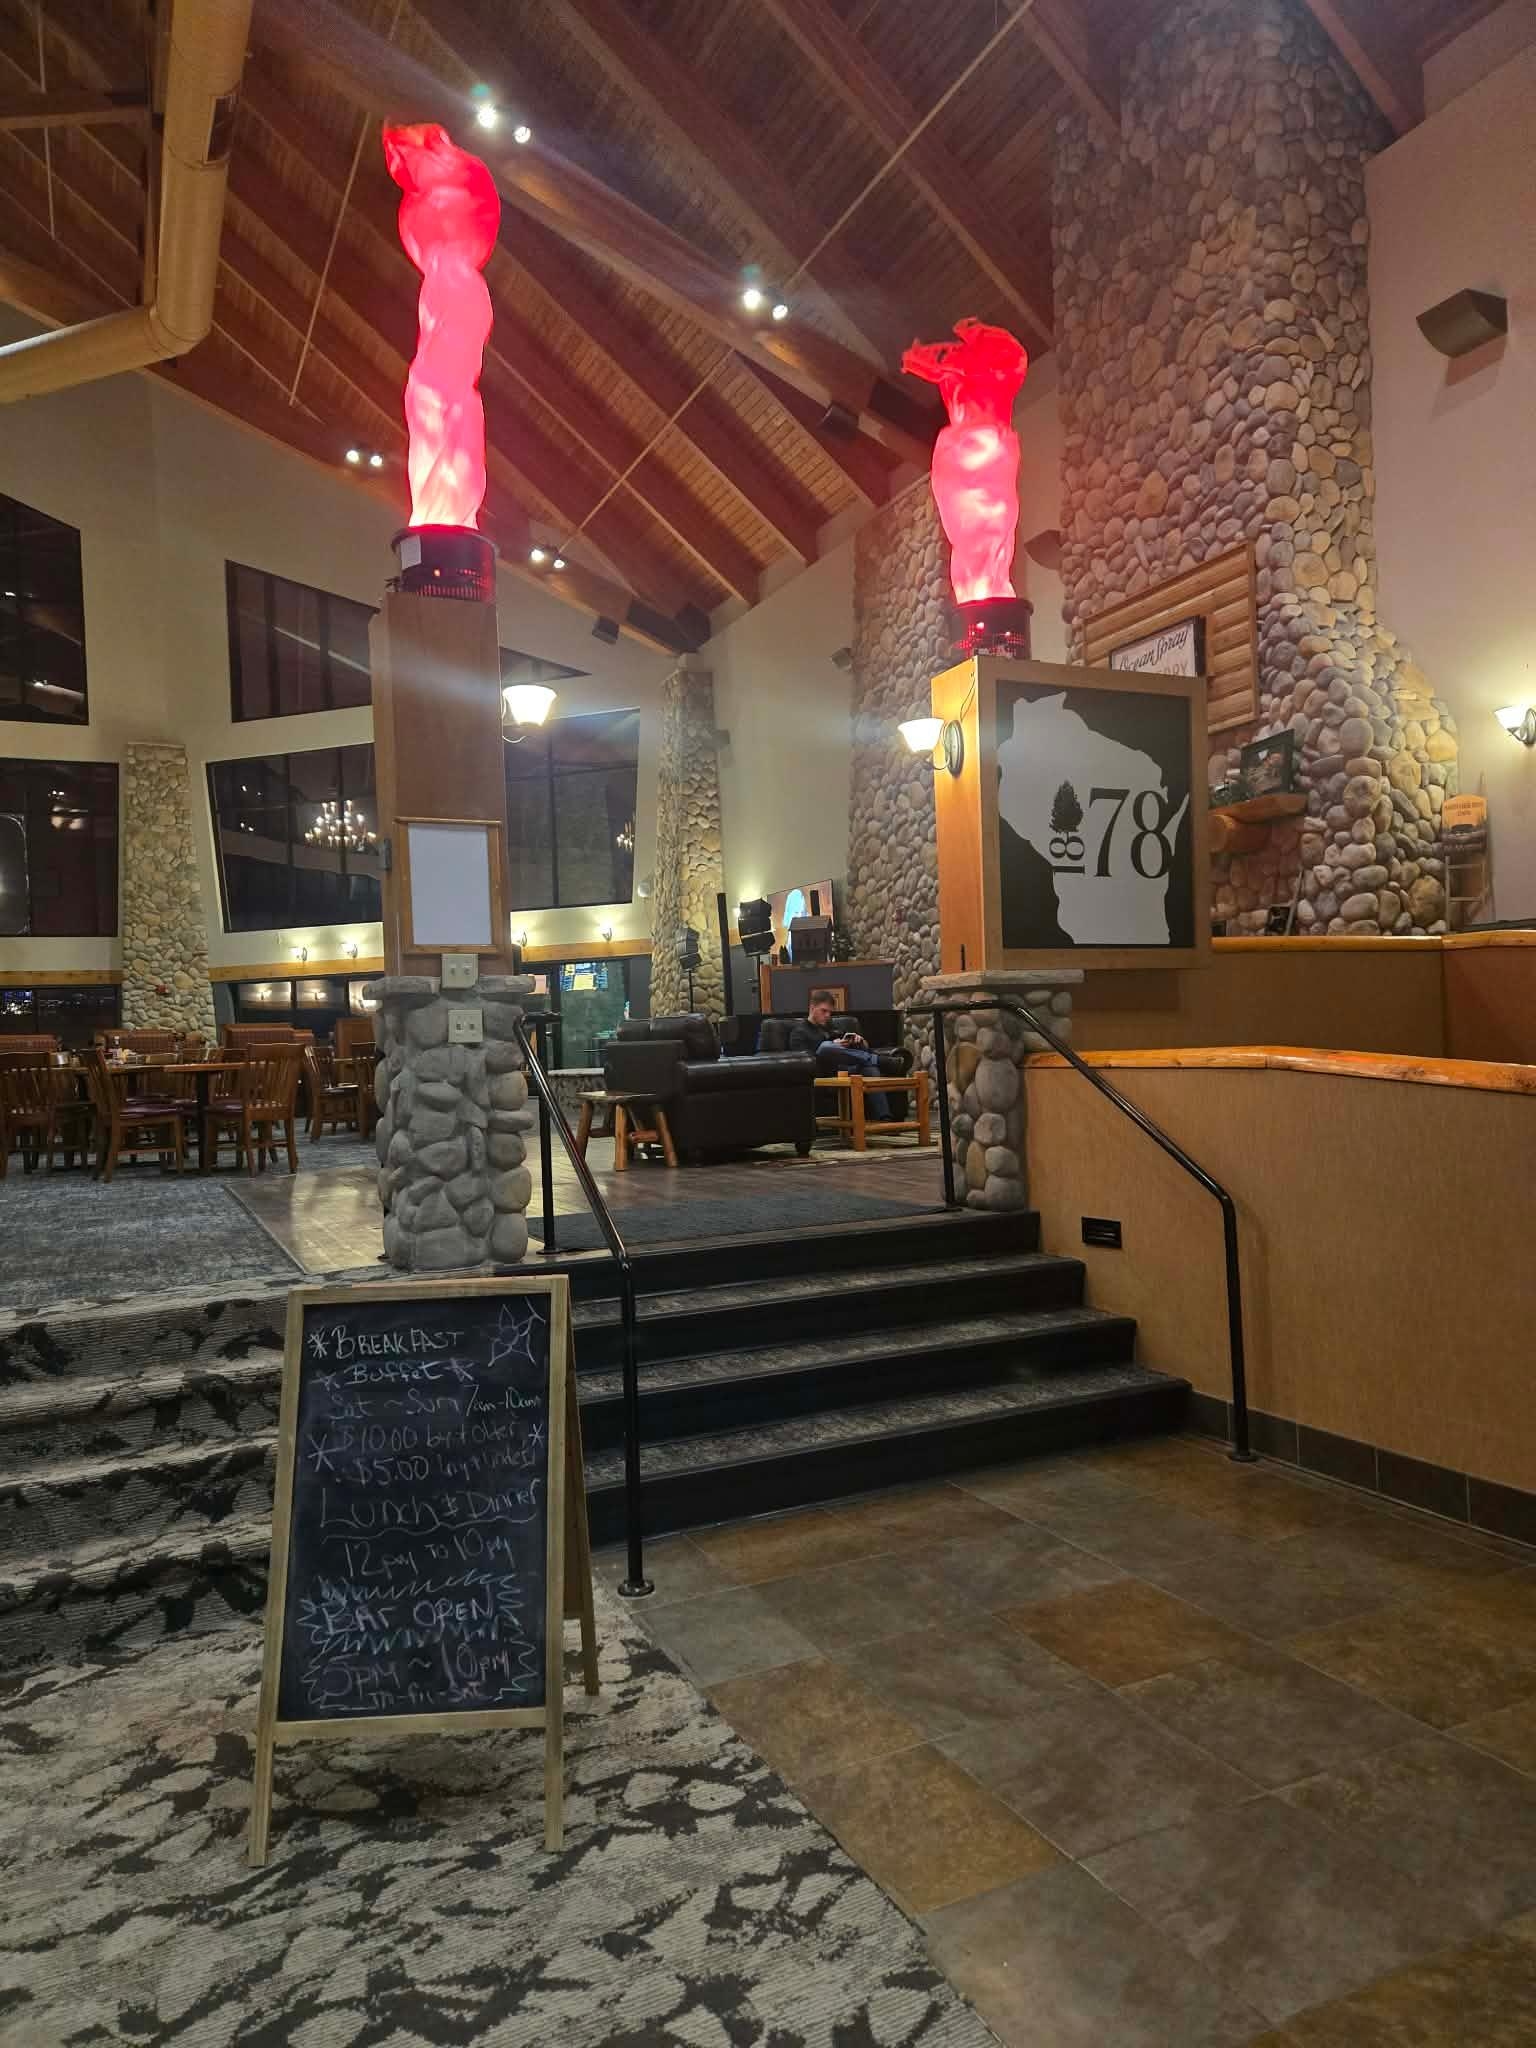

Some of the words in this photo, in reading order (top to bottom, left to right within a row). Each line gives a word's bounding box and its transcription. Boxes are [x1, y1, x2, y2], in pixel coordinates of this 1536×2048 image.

[1152, 627, 1189, 666] Spray
[331, 1325, 464, 1359] BREAKFAST
[413, 1588, 494, 1632] OPEN
